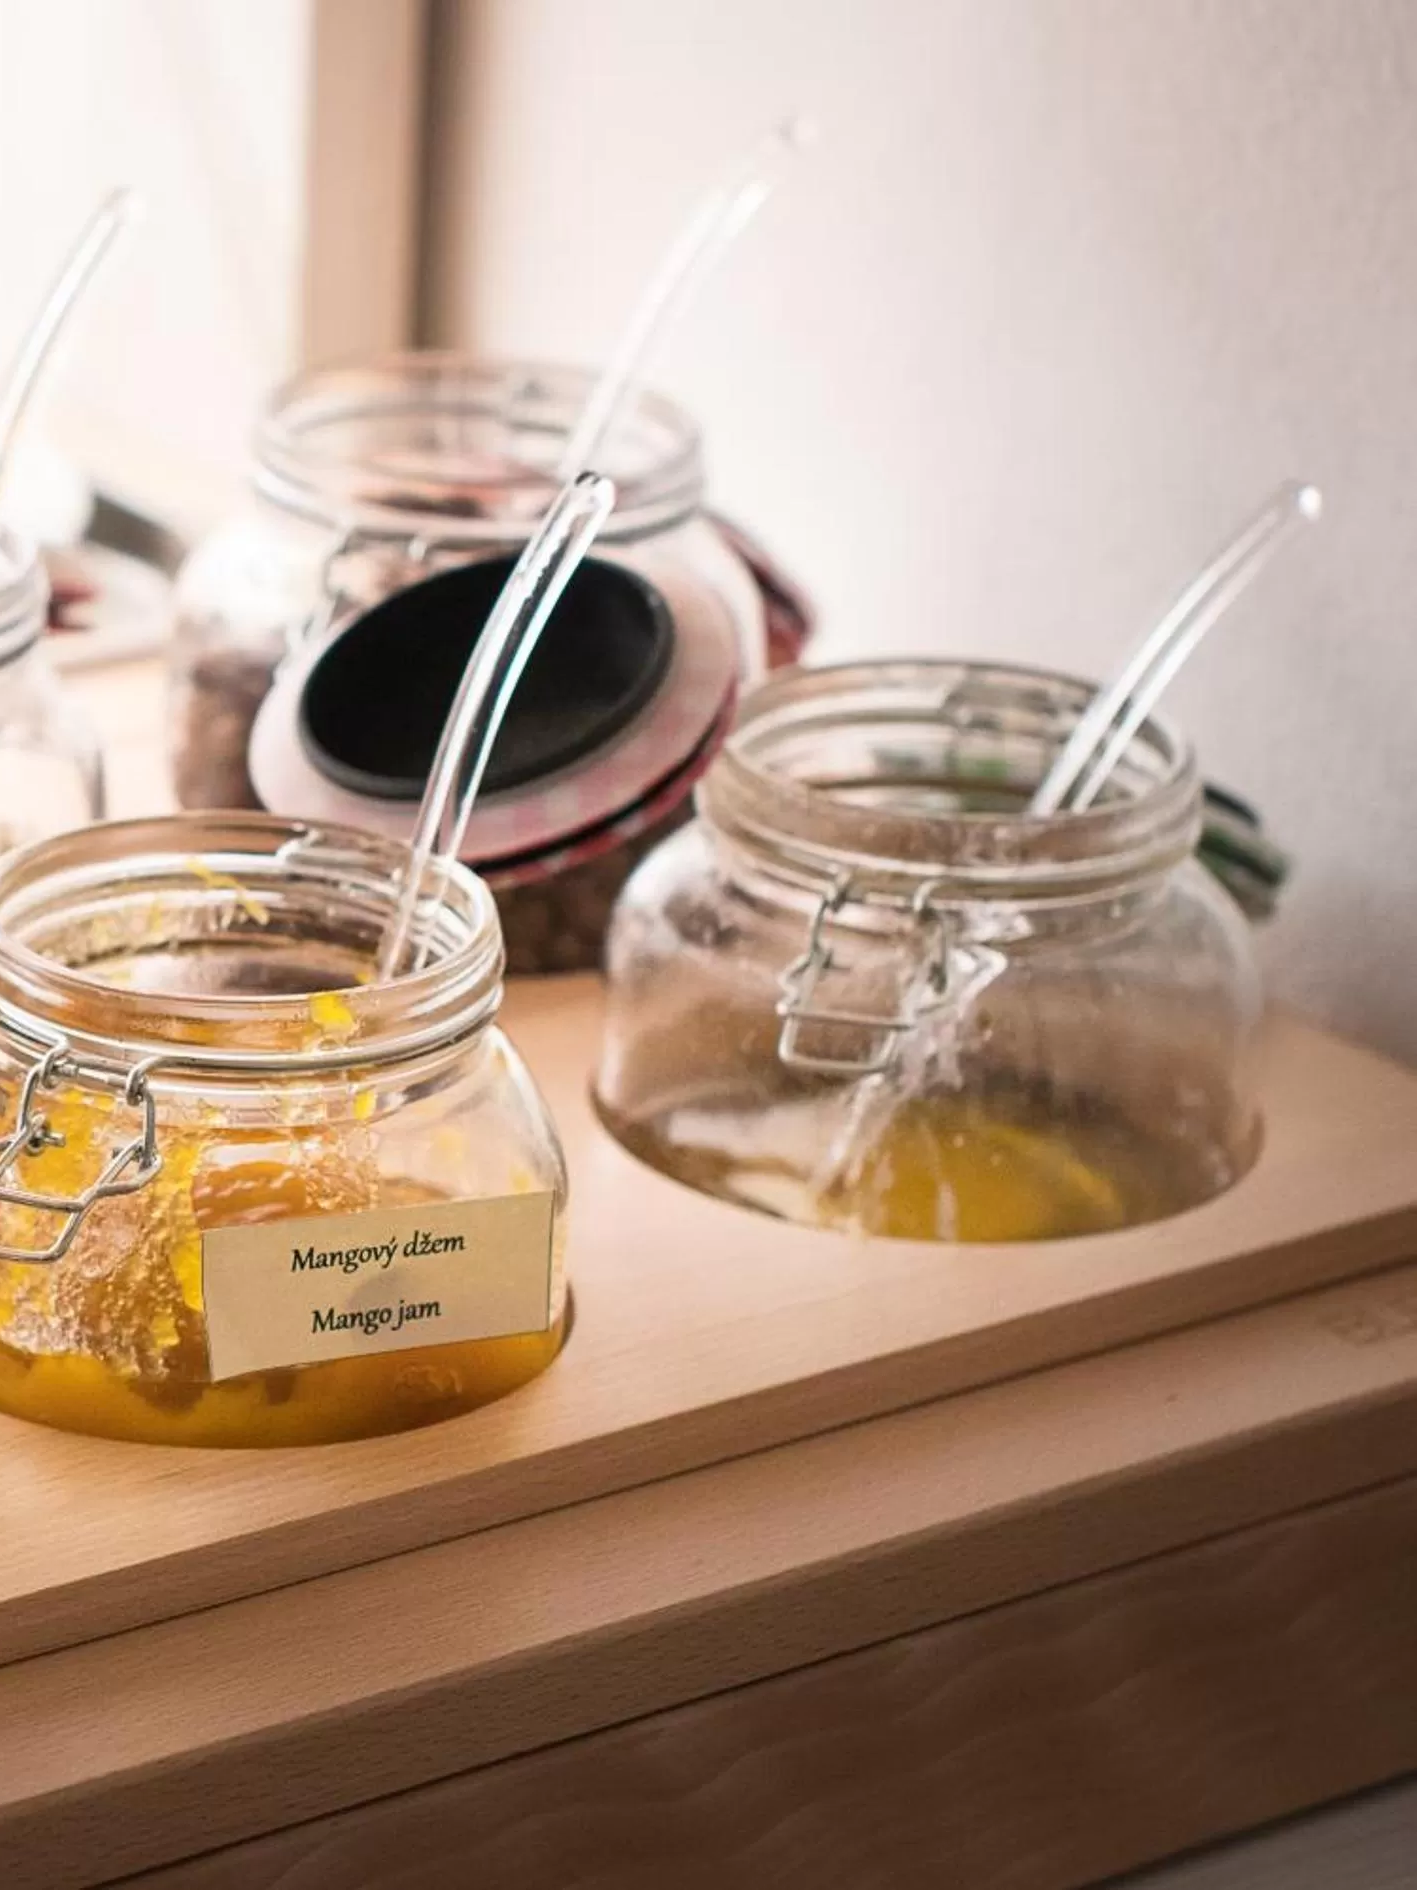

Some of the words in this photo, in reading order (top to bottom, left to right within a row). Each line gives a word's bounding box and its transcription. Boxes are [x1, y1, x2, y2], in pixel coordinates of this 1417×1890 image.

[290, 1237, 398, 1273] Mangový
[403, 1230, 465, 1257] džem
[311, 1303, 391, 1335] Mango
[393, 1299, 441, 1331] jam
